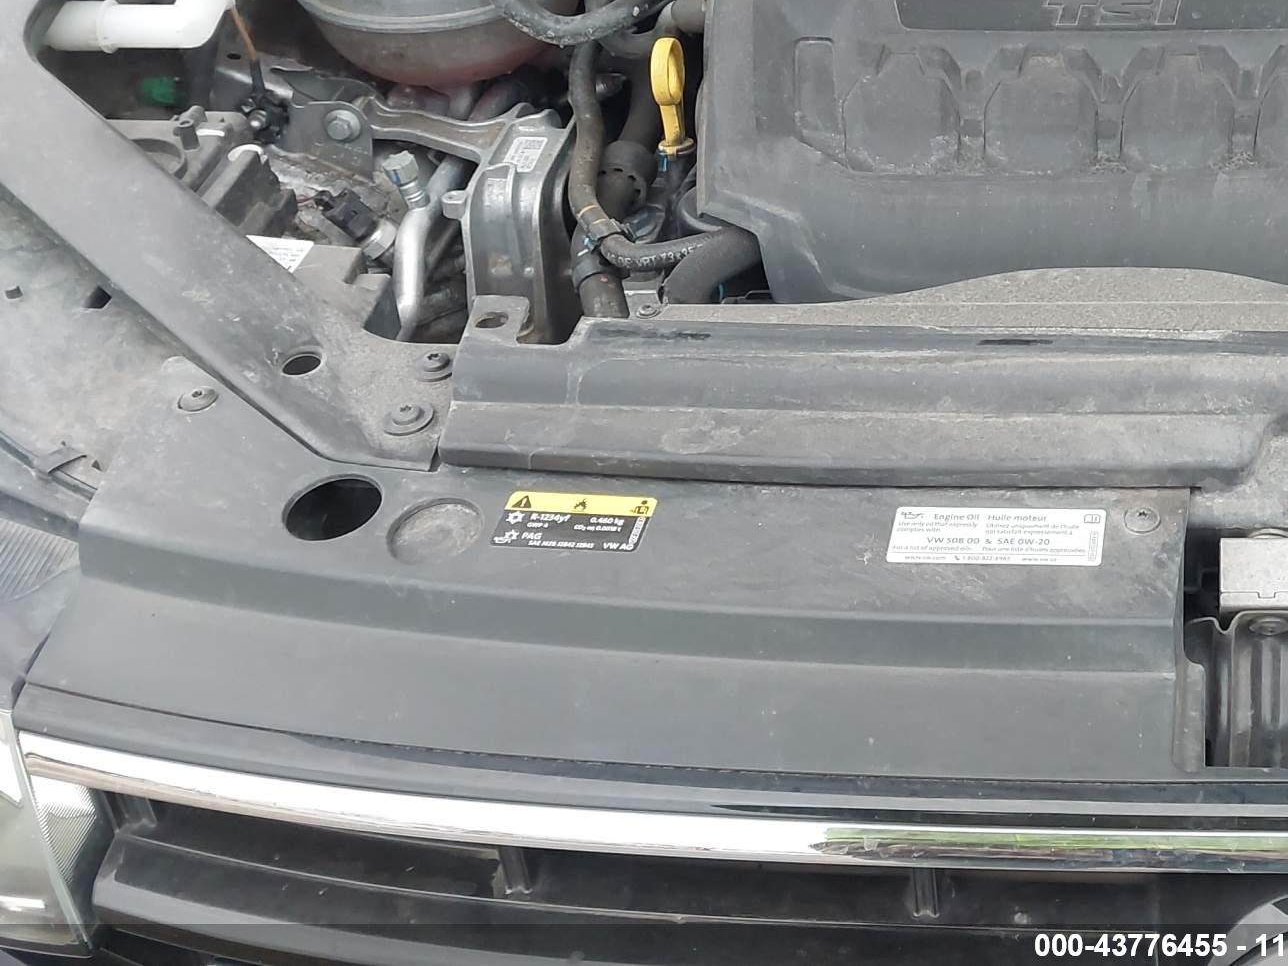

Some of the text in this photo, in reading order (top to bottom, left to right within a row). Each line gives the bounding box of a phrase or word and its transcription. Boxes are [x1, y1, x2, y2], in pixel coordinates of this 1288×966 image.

[530, 513, 571, 523] R-1234yf
[934, 513, 980, 522] Engine Oil
[987, 513, 1047, 523] Huile moteur
[521, 532, 543, 540] PAG
[603, 542, 620, 550] VW
[997, 537, 1014, 545] SAE
[1017, 538, 1050, 546] 0W-20
